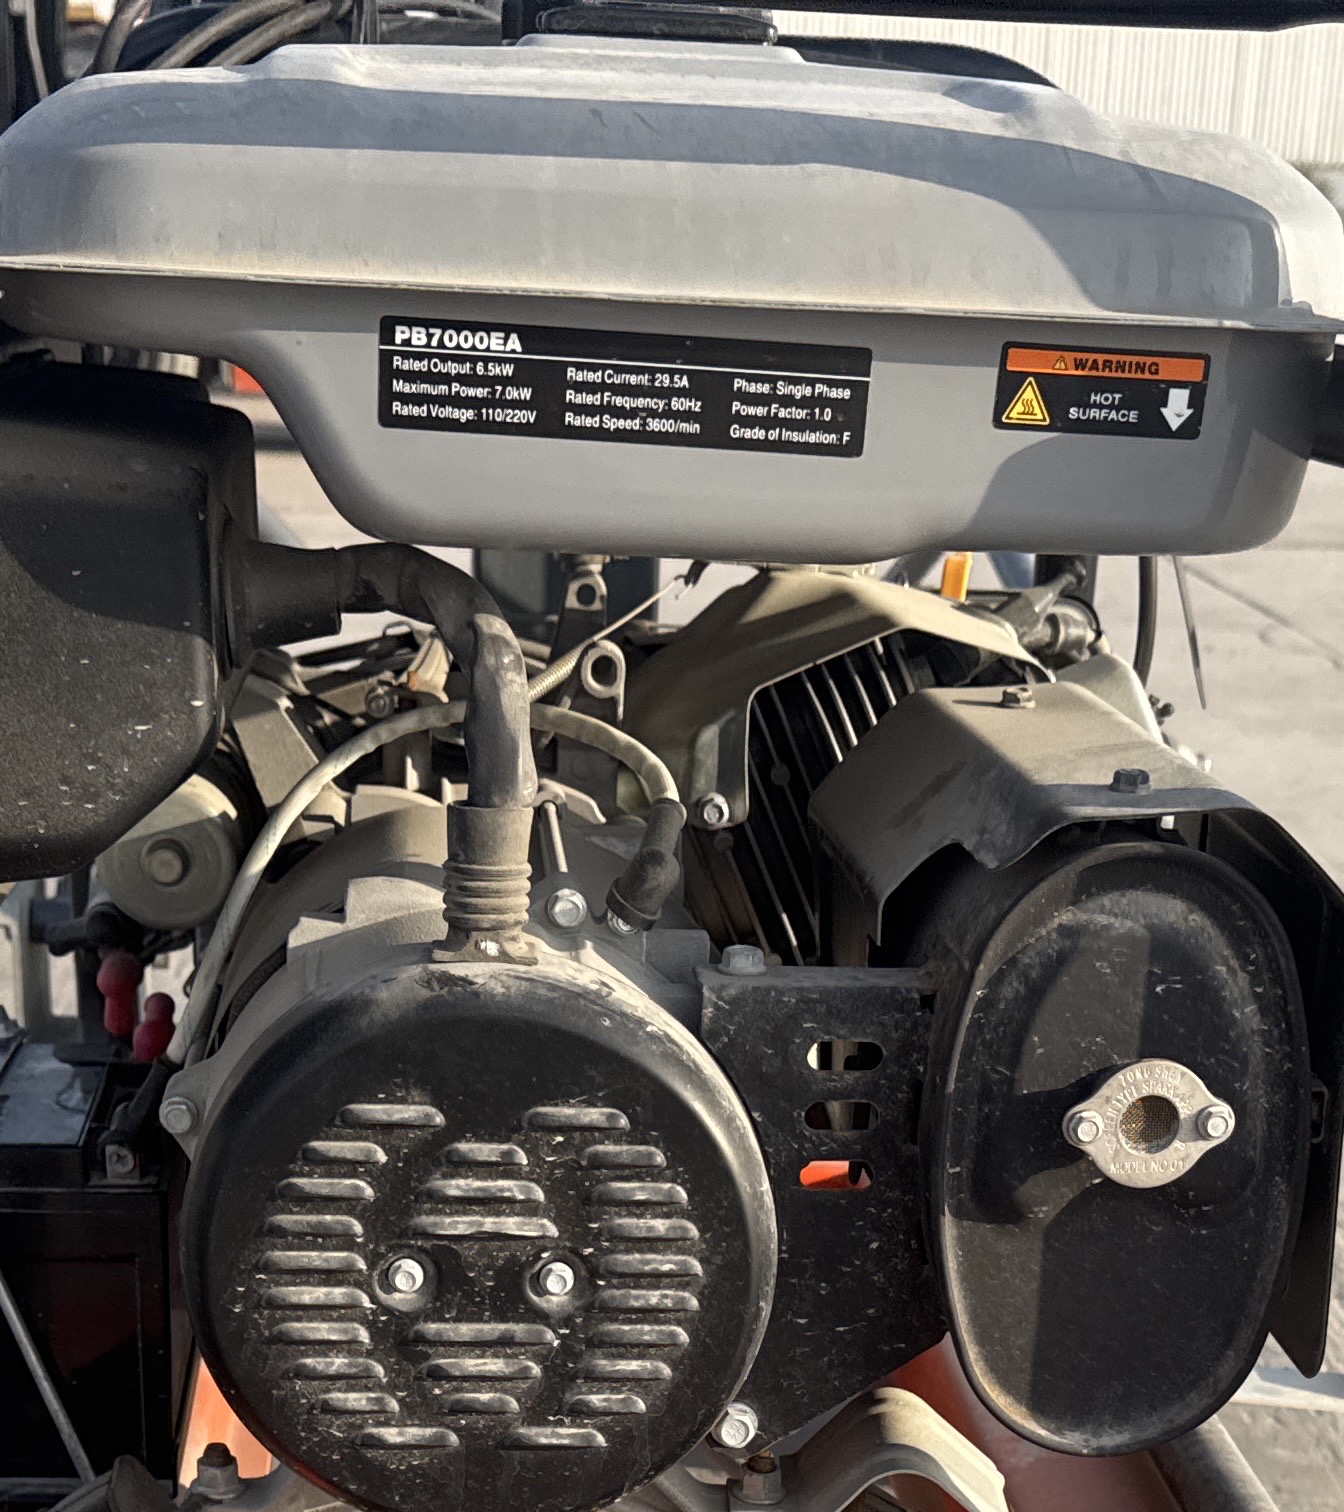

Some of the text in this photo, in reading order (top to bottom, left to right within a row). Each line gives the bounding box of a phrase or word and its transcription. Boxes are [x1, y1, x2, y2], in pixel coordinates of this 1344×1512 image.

[394, 325, 523, 353] PB7000EA
[392, 355, 515, 377] Rated Output: 6.5kW
[1073, 356, 1160, 376] WARNING
[566, 367, 690, 389] Rated Current: 29.5A
[733, 378, 852, 400] Phase: Single Phase
[392, 378, 533, 401] Maximum Power: 7.0kW
[1089, 392, 1123, 406] HOT
[392, 401, 538, 424] Rated Voltage: 110/220V
[565, 390, 703, 413] Rated Frequency: 60Hz
[731, 401, 832, 421] Power Factor: 1.0
[564, 412, 701, 435] Rated Speed: 3600/min
[1068, 407, 1140, 423] SURFACE
[729, 424, 852, 446] Grade of Insulation: F
[1109, 1158, 1186, 1175] MODEL NO 01
